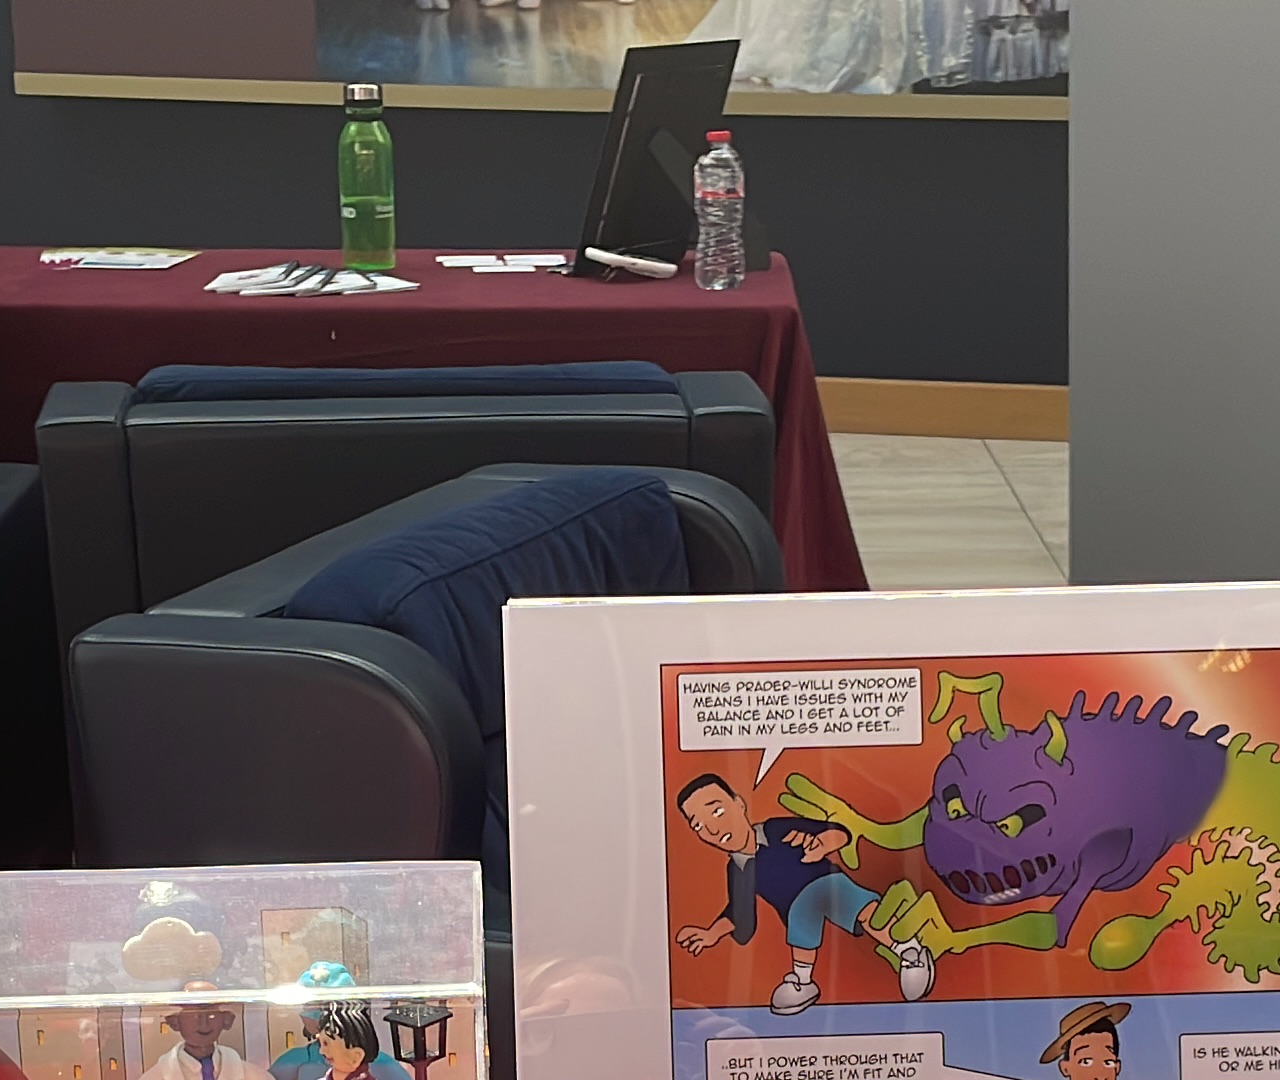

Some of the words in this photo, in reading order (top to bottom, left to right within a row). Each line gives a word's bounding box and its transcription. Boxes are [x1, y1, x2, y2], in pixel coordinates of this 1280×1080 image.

[683, 682, 730, 694] HAVING
[736, 679, 833, 692] PRADER-WILLI
[838, 677, 917, 691] SYNDROME
[693, 696, 742, 708] MEANS
[748, 696, 751, 706] I
[756, 694, 789, 706] HAVE
[794, 692, 847, 706] ISSUES
[851, 692, 883, 704] WITH
[888, 691, 908, 703] MY
[697, 709, 761, 722] BALANCE
[766, 709, 794, 721] AND
[800, 708, 802, 719] I
[807, 708, 834, 719] GET
[839, 708, 849, 719] A
[853, 706, 880, 718] LOT
[885, 706, 904, 717] OF
[703, 724, 733, 737] PAIN
[738, 724, 751, 736] IN
[756, 724, 776, 735] MY
[781, 722, 818, 734] LEGS
[824, 722, 853, 733] AND
[760, 1058, 762, 1068] I
[768, 1056, 818, 1068] POWER
[822, 1054, 888, 1066] THROUGH
[892, 1052, 924, 1064] THAT
[1193, 1048, 1207, 1058] IS
[1212, 1047, 1229, 1058] HE
[797, 1070, 834, 1080] SURE
[840, 1068, 859, 1080] I'M
[863, 1068, 883, 1080] FIT
[887, 1067, 916, 1079] AND
[1219, 1060, 1240, 1072] OR
[1244, 1060, 1264, 1071] ME
